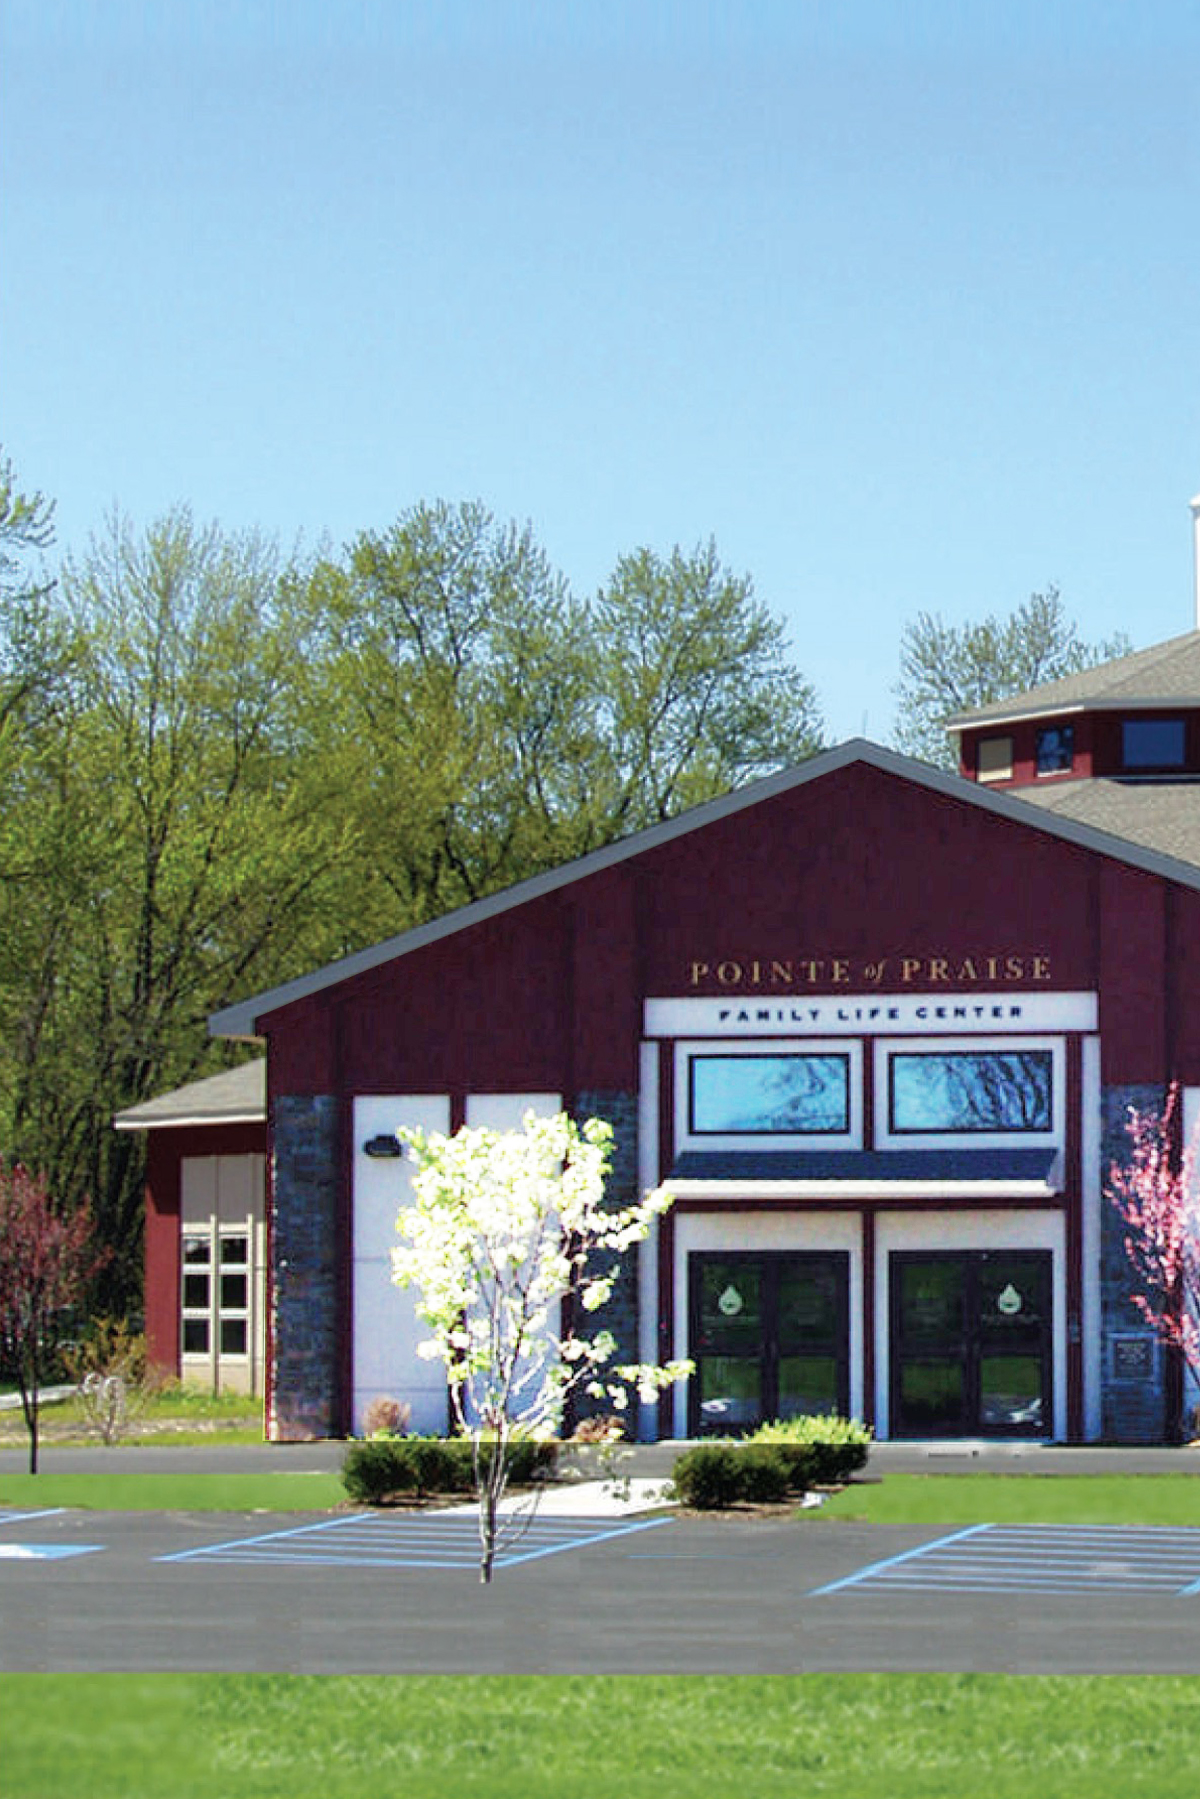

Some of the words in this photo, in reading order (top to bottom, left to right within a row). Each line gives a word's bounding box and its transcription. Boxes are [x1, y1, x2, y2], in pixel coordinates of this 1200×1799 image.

[690, 959, 851, 985] POINTE
[864, 959, 888, 981] of
[901, 956, 1053, 982] PRAISE
[718, 1008, 821, 1022] FAMILY
[837, 1007, 900, 1021] LIFE
[915, 1006, 1023, 1020] CENTER
